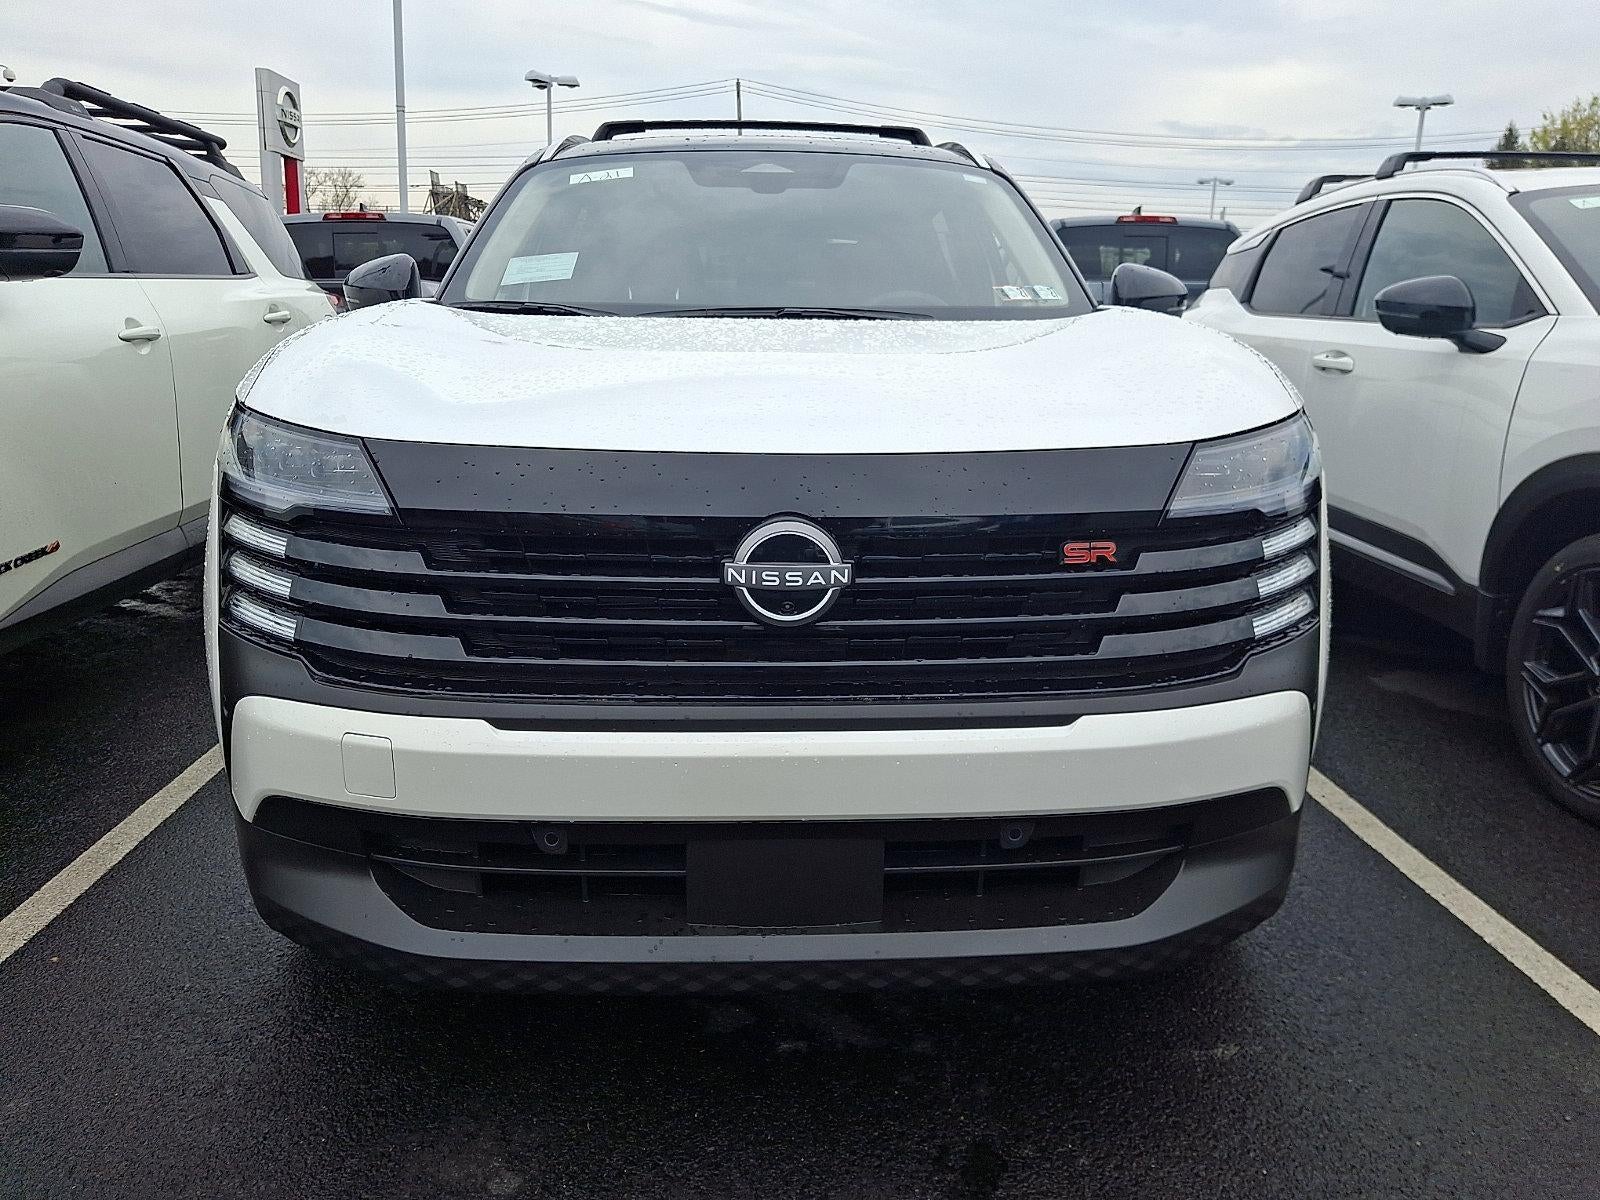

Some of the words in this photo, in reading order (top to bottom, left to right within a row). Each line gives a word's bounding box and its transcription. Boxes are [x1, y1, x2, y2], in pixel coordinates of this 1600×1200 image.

[13, 544, 50, 569] CREEK
[1063, 541, 1117, 564] SR
[727, 567, 849, 586] NISSAN
